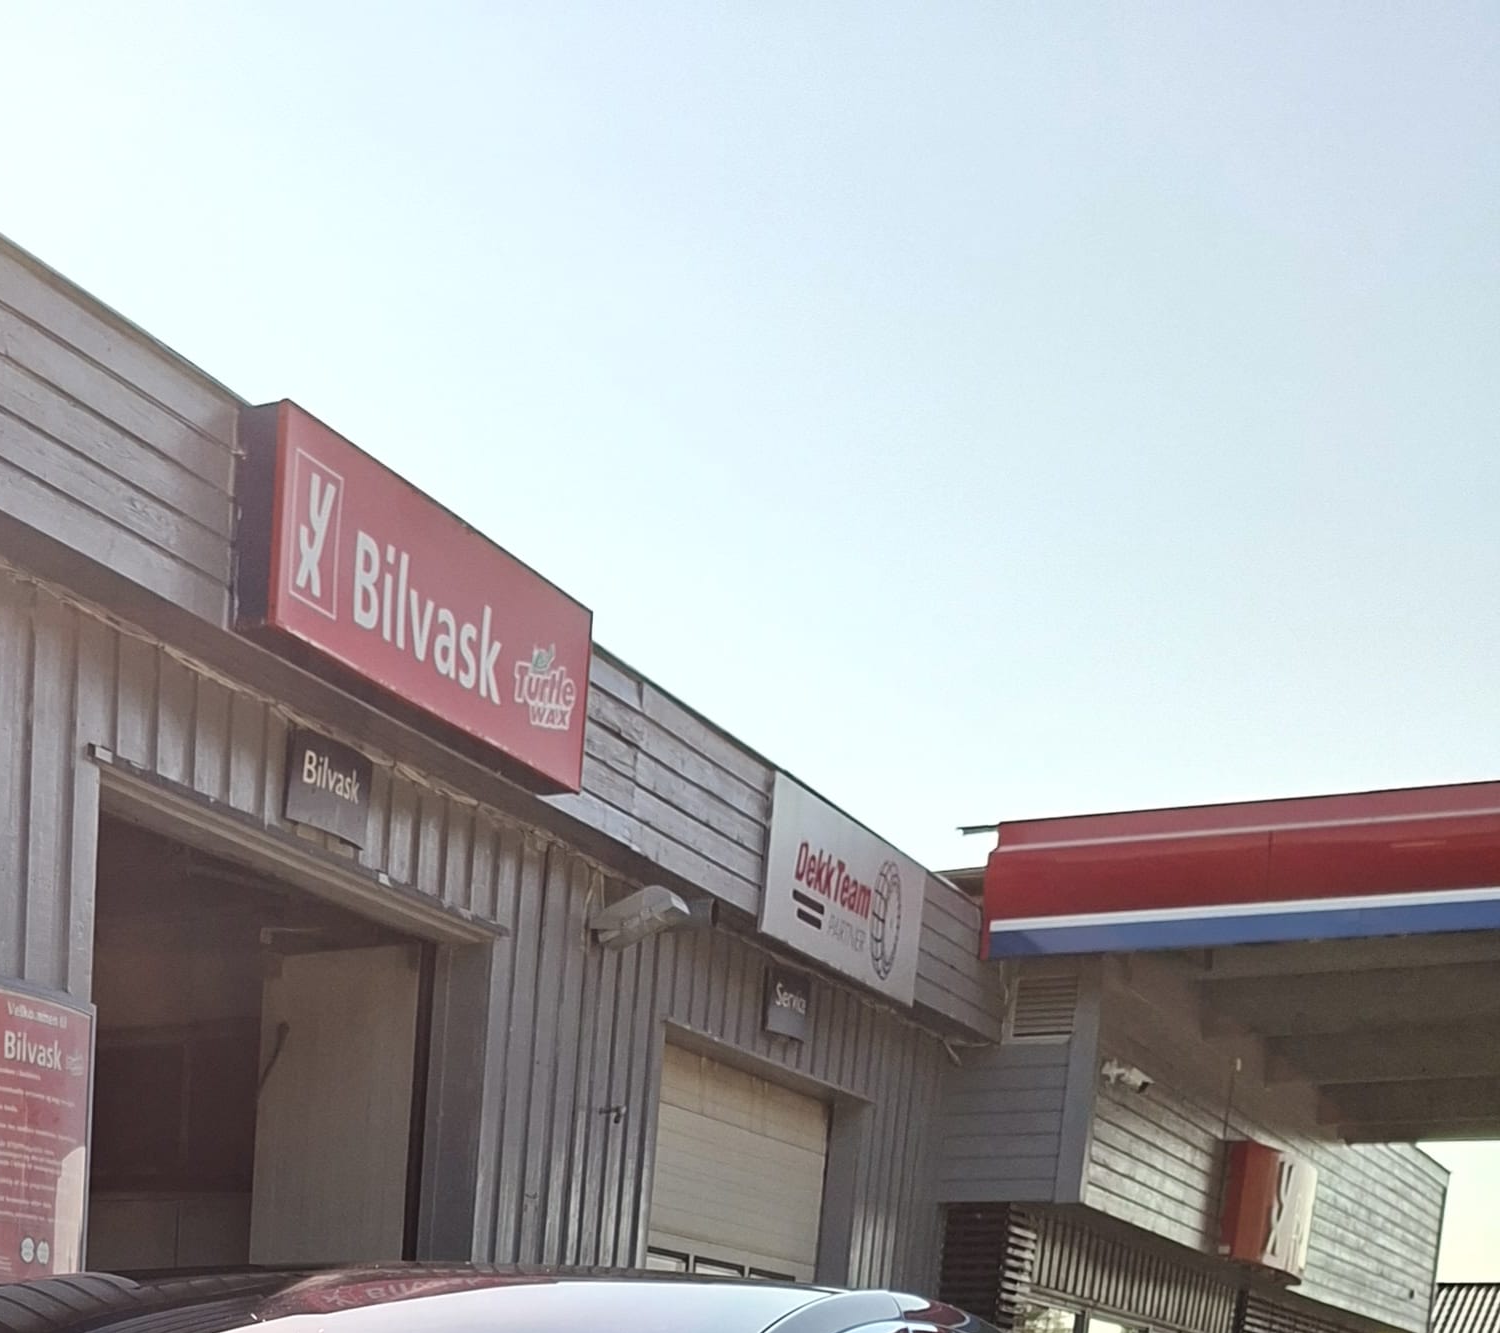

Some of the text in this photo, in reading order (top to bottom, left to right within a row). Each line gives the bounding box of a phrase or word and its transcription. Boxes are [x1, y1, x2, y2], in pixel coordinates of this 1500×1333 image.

[352, 530, 501, 704] Bilvask
[514, 661, 575, 709] Turtle
[528, 702, 570, 730] WAX
[303, 749, 359, 804] Bilvask
[3, 1029, 62, 1071] Bilvask
